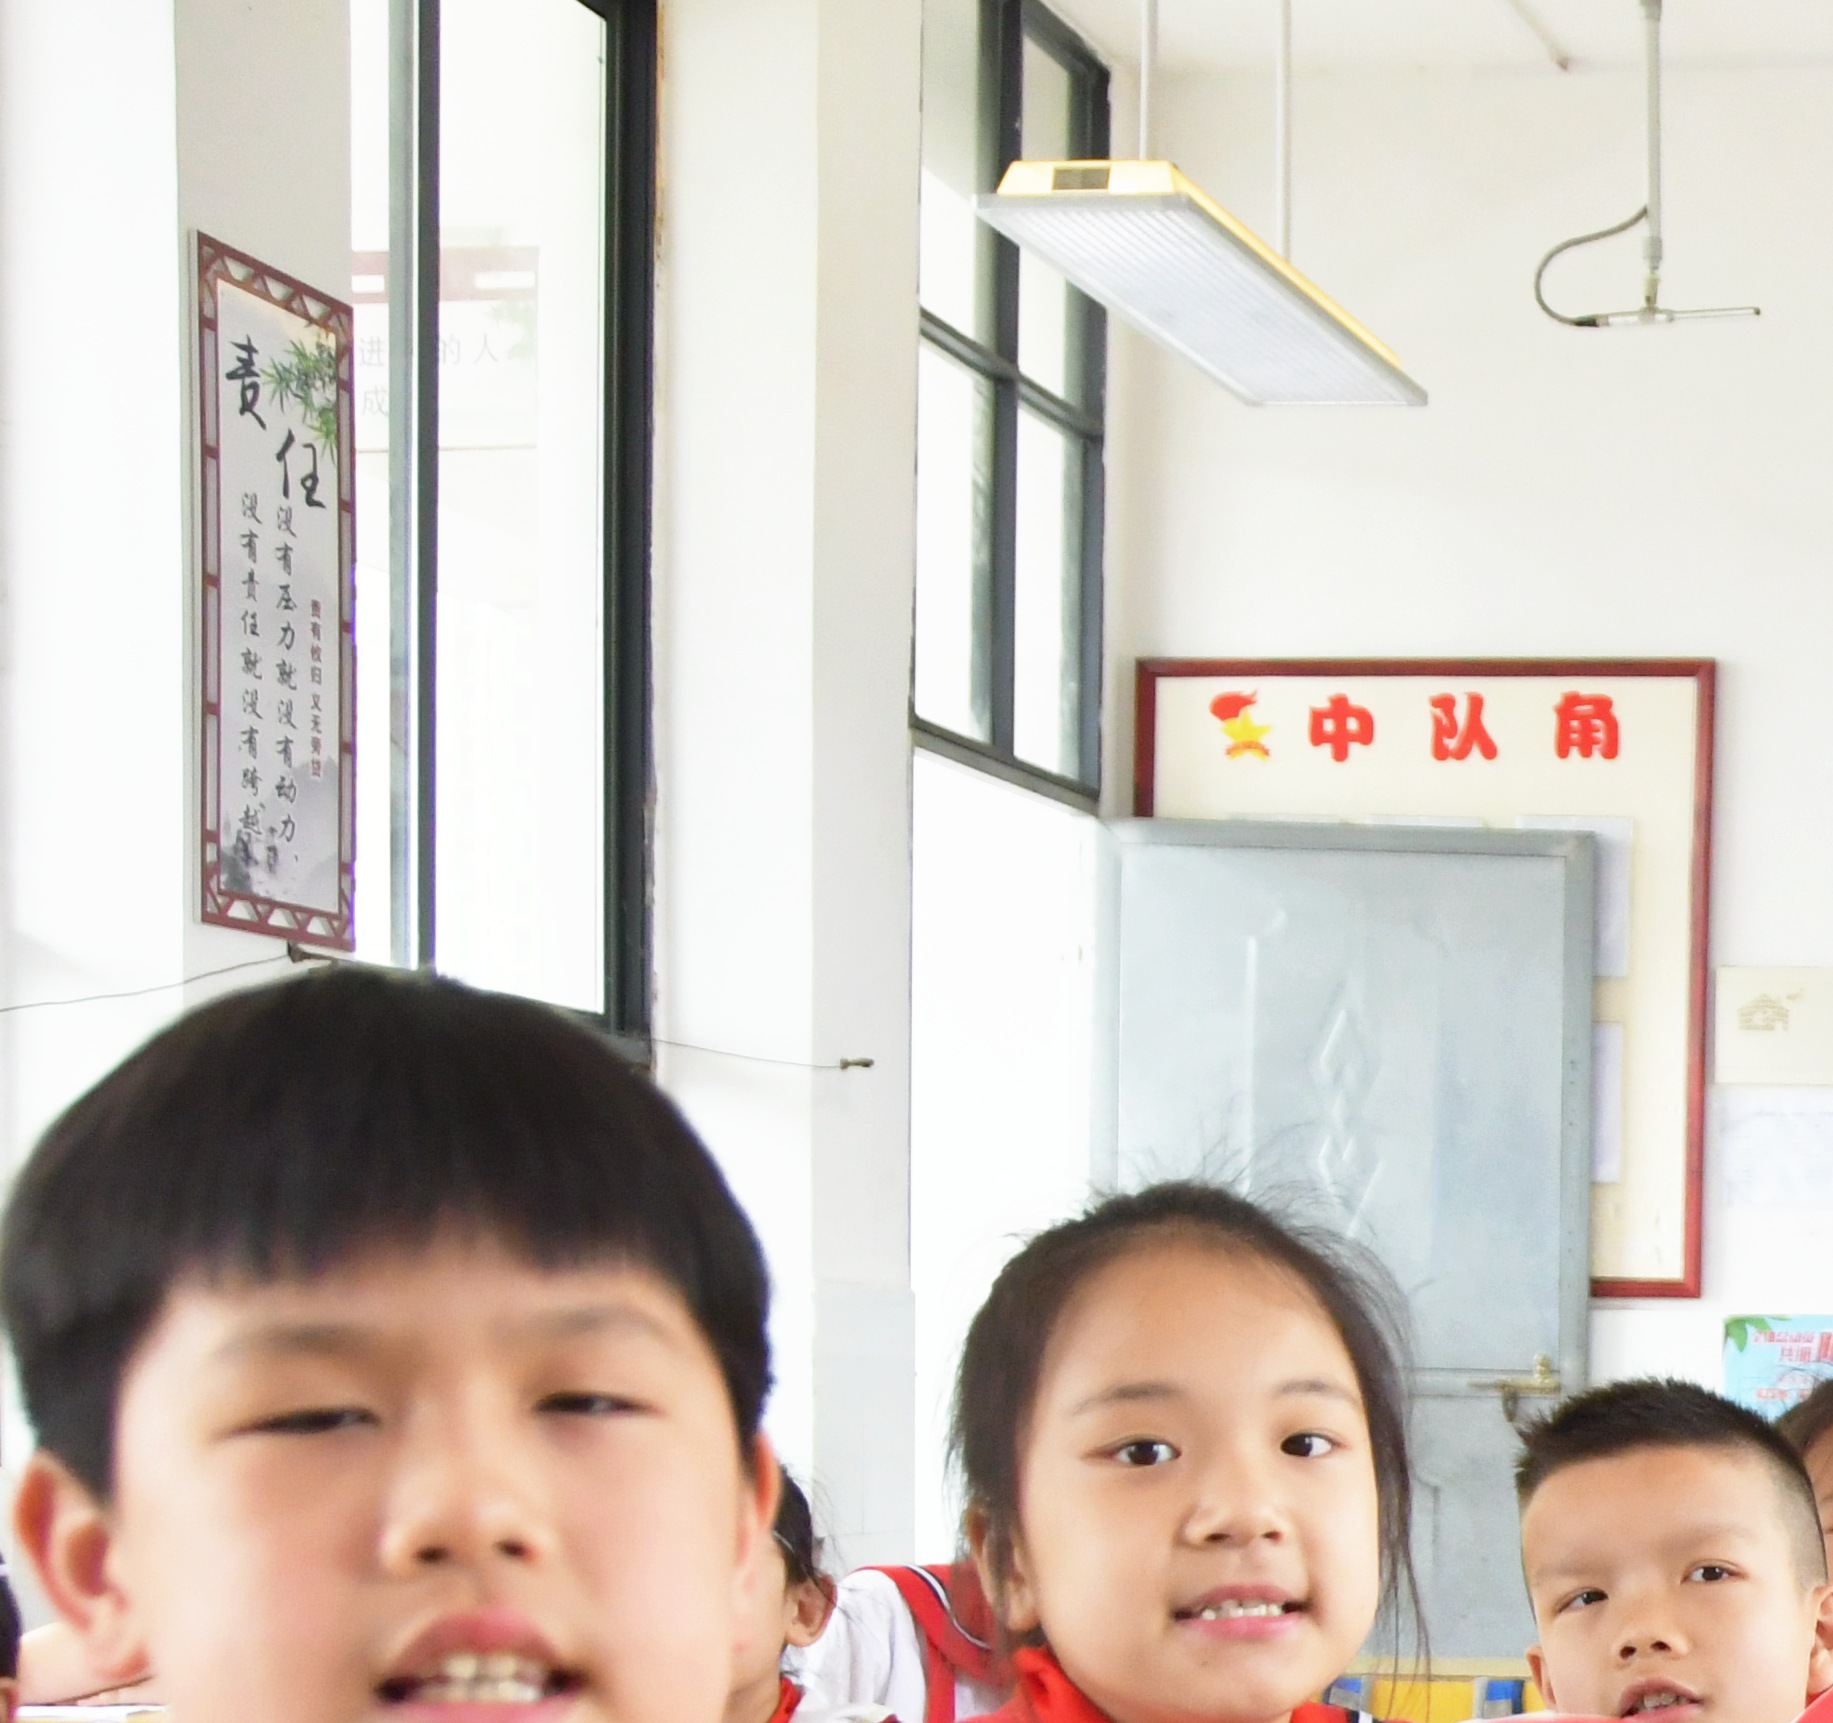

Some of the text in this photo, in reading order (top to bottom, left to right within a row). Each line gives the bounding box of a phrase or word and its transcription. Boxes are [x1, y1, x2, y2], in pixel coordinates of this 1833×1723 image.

[226, 334, 327, 510] 责任
[1308, 690, 1622, 762] 中队角
